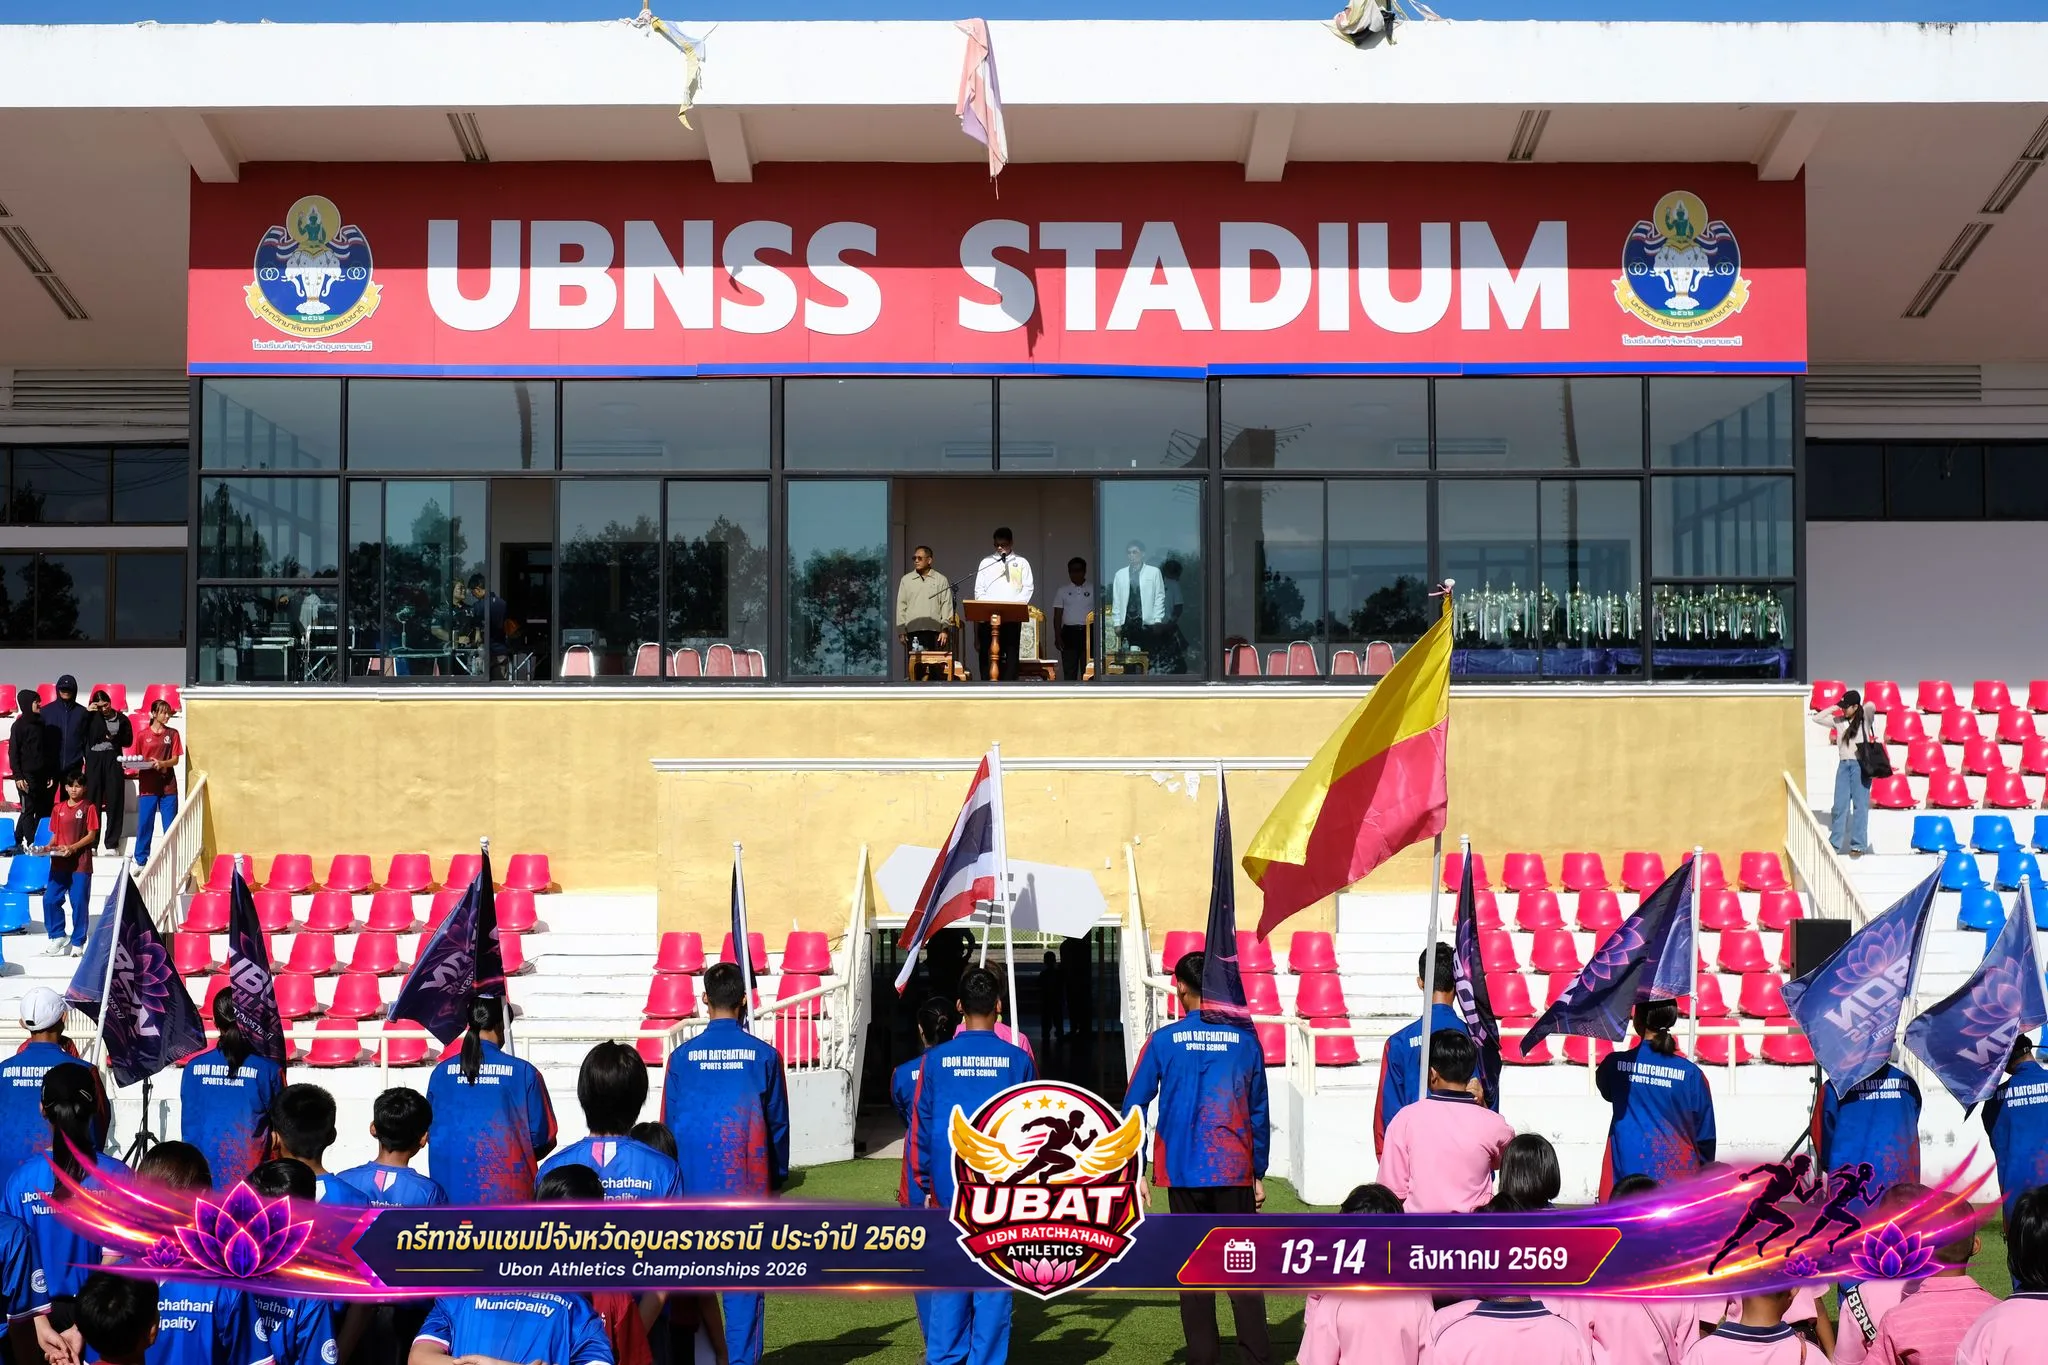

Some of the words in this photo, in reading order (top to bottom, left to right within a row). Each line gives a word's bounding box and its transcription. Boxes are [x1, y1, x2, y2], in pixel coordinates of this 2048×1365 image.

[427, 219, 881, 335] UBNSS
[958, 219, 1570, 333] STADIUM
[1172, 1031, 1192, 1043] UBON
[1193, 1031, 1240, 1044] RATCHATHANI
[1186, 1043, 1206, 1051] SPORTS
[1206, 1043, 1228, 1052] SCHOOL
[688, 1050, 707, 1061] UBON
[709, 1049, 756, 1061] RATCHATHANI
[700, 1062, 722, 1070] SPORTS
[722, 1062, 744, 1070] SCHOOL
[942, 1056, 961, 1068] UBON
[962, 1056, 1010, 1068] RATCHATHANI
[954, 1068, 975, 1077] SPORTS
[976, 1068, 998, 1077] SCHOOL
[1637, 1062, 1686, 1081] RATCHATHANI
[13, 1079, 33, 1087] SPORTS
[1628, 1075, 1650, 1085] SPORTS
[1650, 1077, 1672, 1088] SCHOOL
[1880, 1090, 1901, 1099] SCHOOL
[475, 1297, 555, 1317] Municipality
